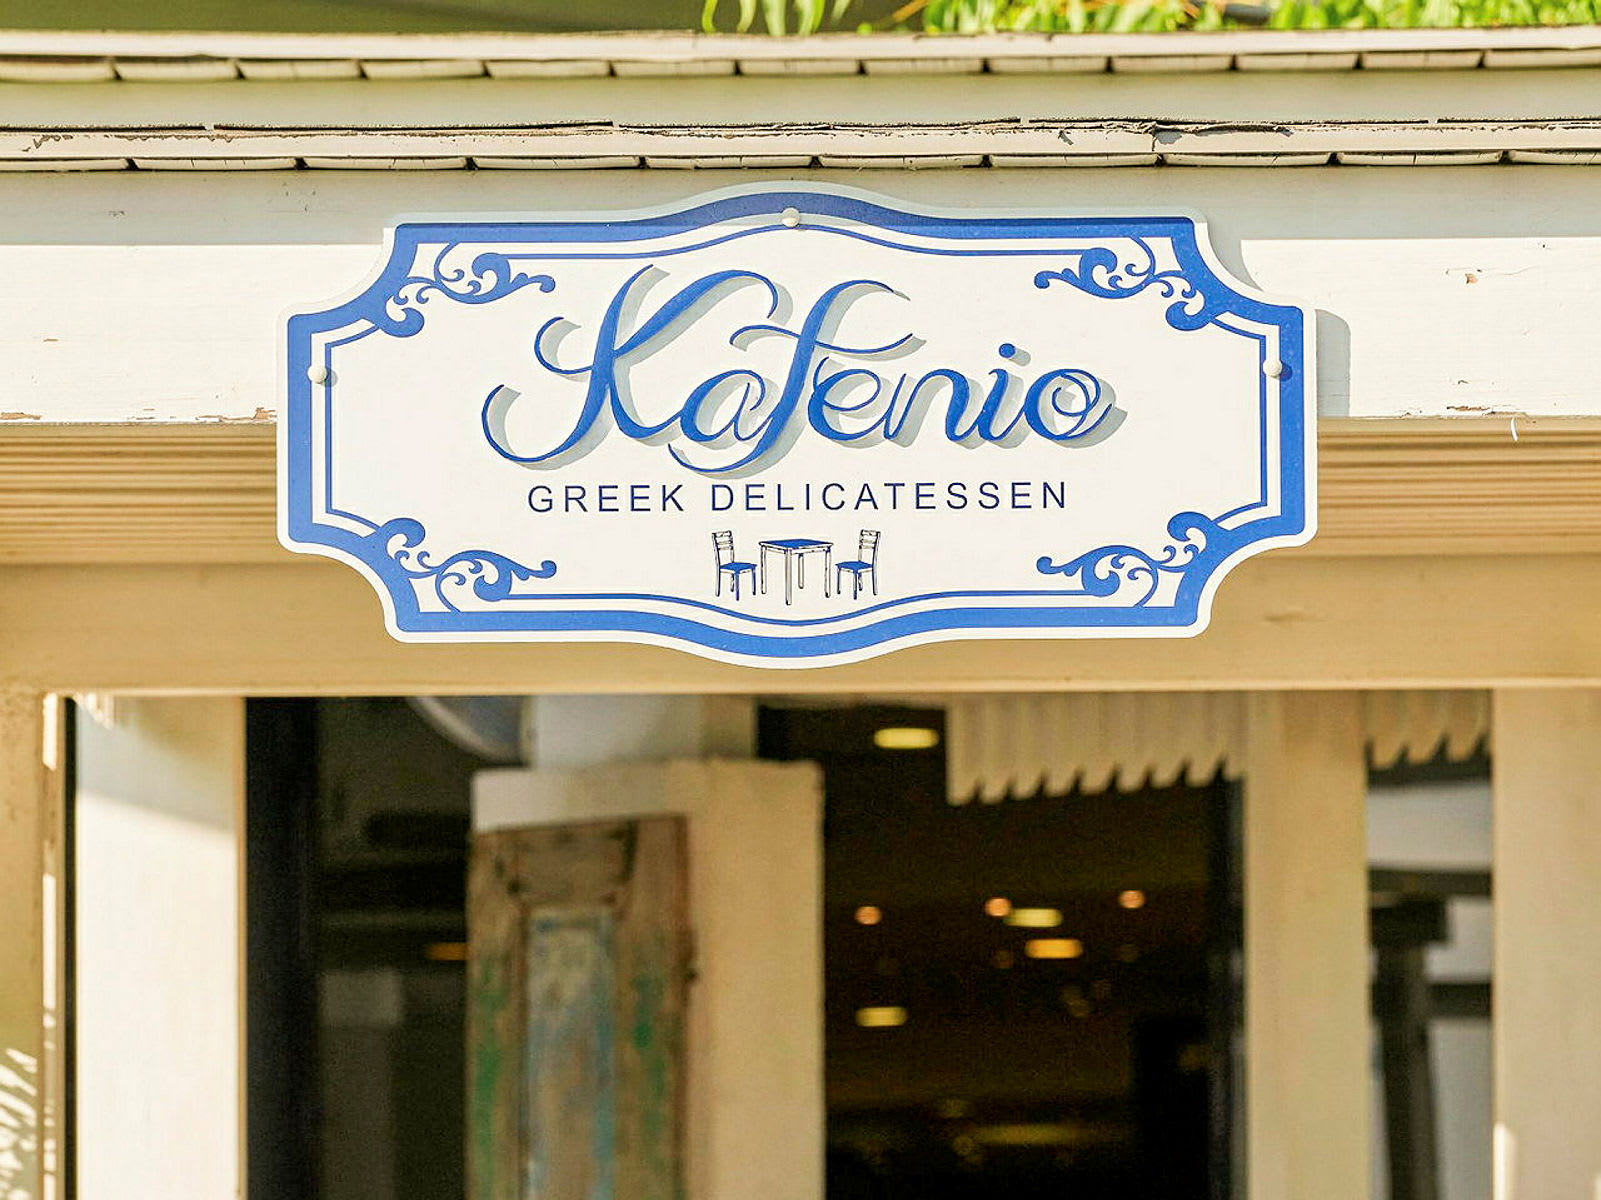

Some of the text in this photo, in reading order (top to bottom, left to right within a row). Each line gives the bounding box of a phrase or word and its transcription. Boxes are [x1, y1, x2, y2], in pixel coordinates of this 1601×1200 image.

[481, 263, 1113, 473] Kafenio
[527, 481, 1066, 513] GREEK DELICATESSEN
